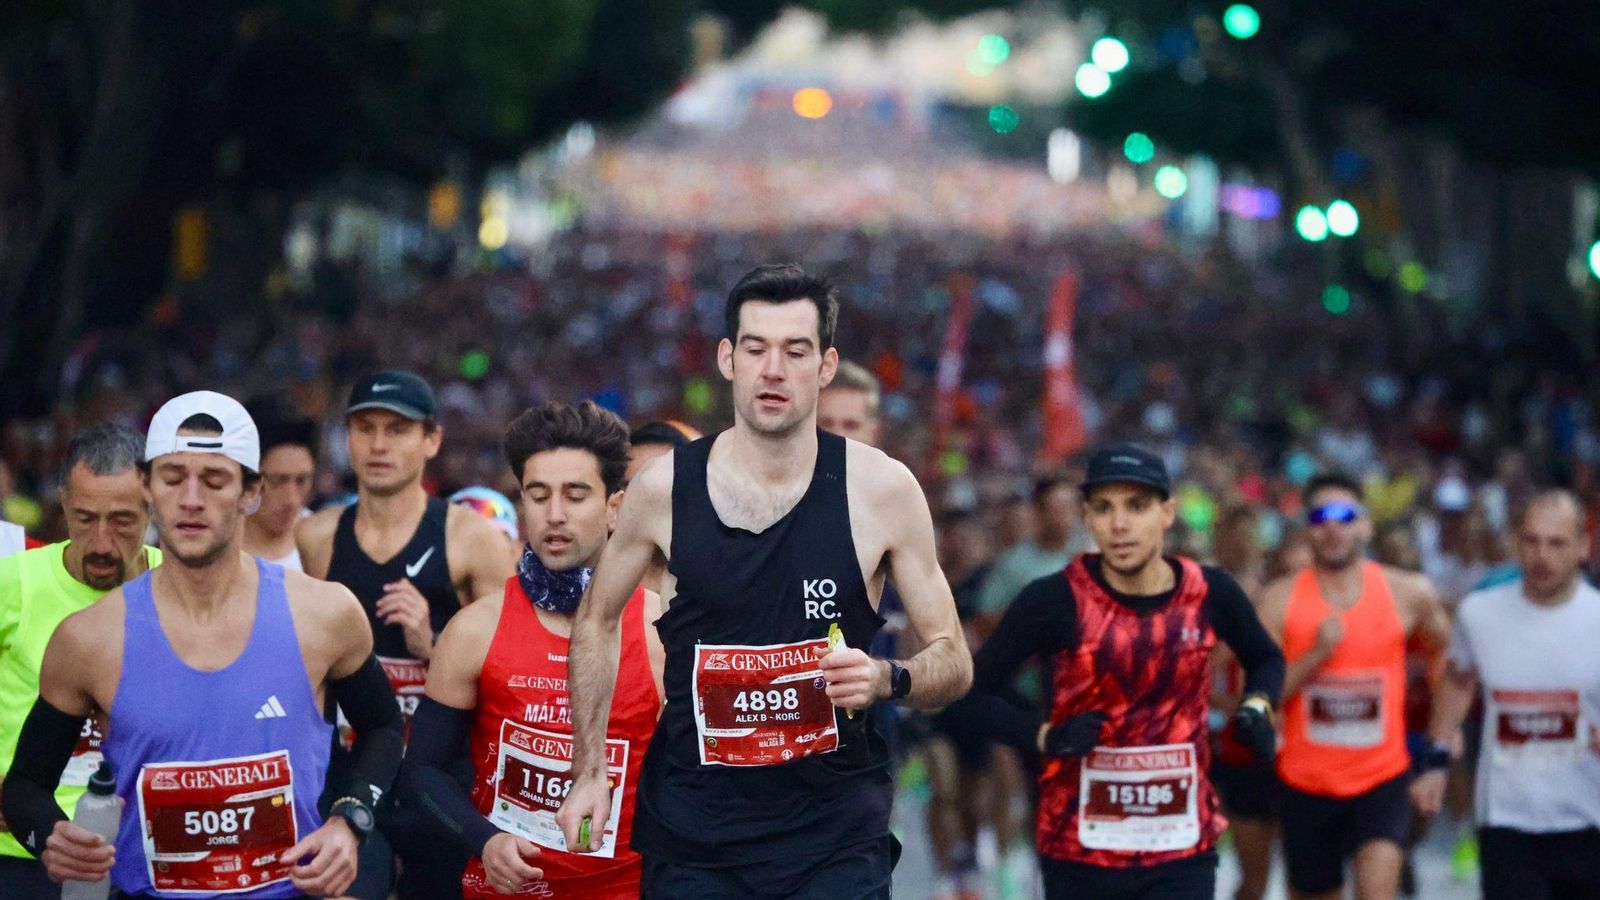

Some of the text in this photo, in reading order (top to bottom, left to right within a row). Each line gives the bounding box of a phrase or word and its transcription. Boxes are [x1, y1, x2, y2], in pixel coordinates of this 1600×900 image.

[803, 578, 837, 599] KO
[804, 600, 842, 619] RC.
[733, 687, 799, 712] 4898
[735, 714, 758, 723] ALEX
[760, 714, 767, 722] B
[775, 711, 800, 721] KORC
[794, 732, 818, 744] 42K
[180, 761, 282, 789] GENERALI
[519, 789, 544, 804] JOHAN
[1107, 784, 1174, 805] 15186
[184, 806, 256, 835] 5087
[206, 835, 240, 846] JORGE
